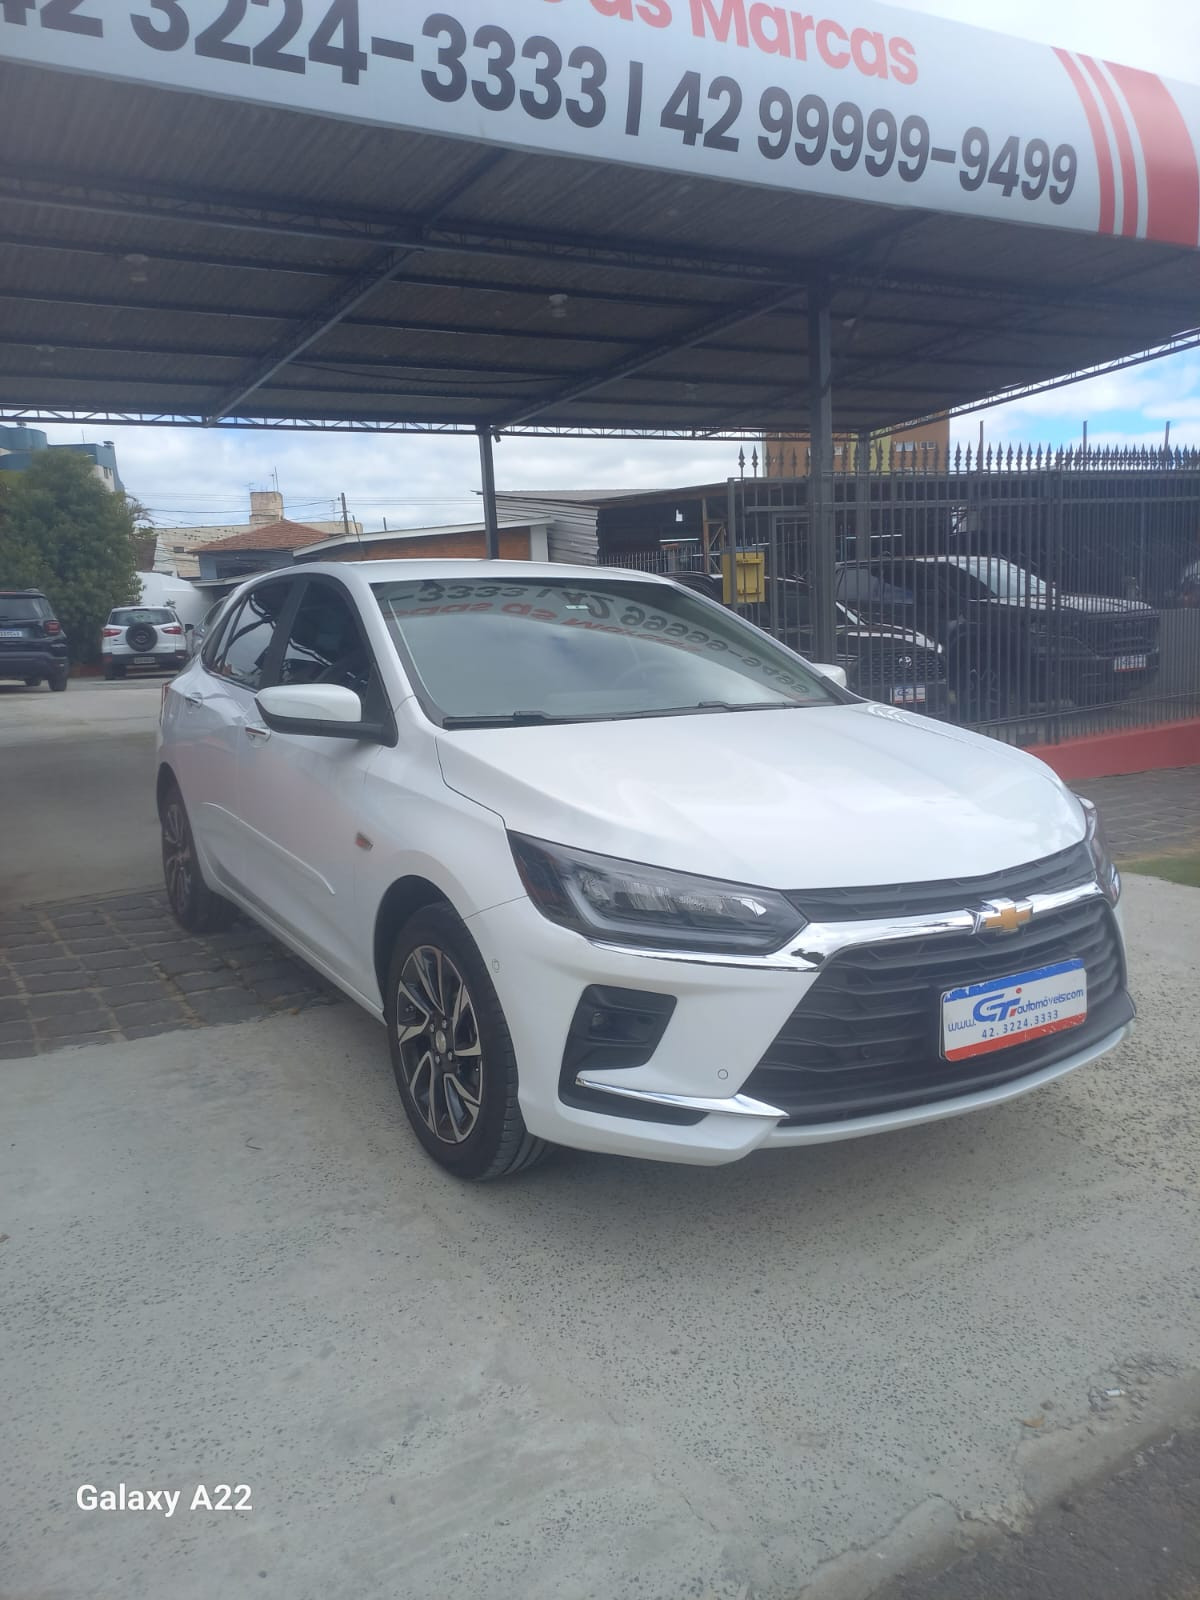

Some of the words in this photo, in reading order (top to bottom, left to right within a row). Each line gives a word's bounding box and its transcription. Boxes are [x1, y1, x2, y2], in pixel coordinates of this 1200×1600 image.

[689, 0, 918, 85] Marcas
[660, 71, 743, 152] 42
[758, 86, 1078, 205] 99999-9499
[982, 1010, 1059, 1039] 42.3224.3333
